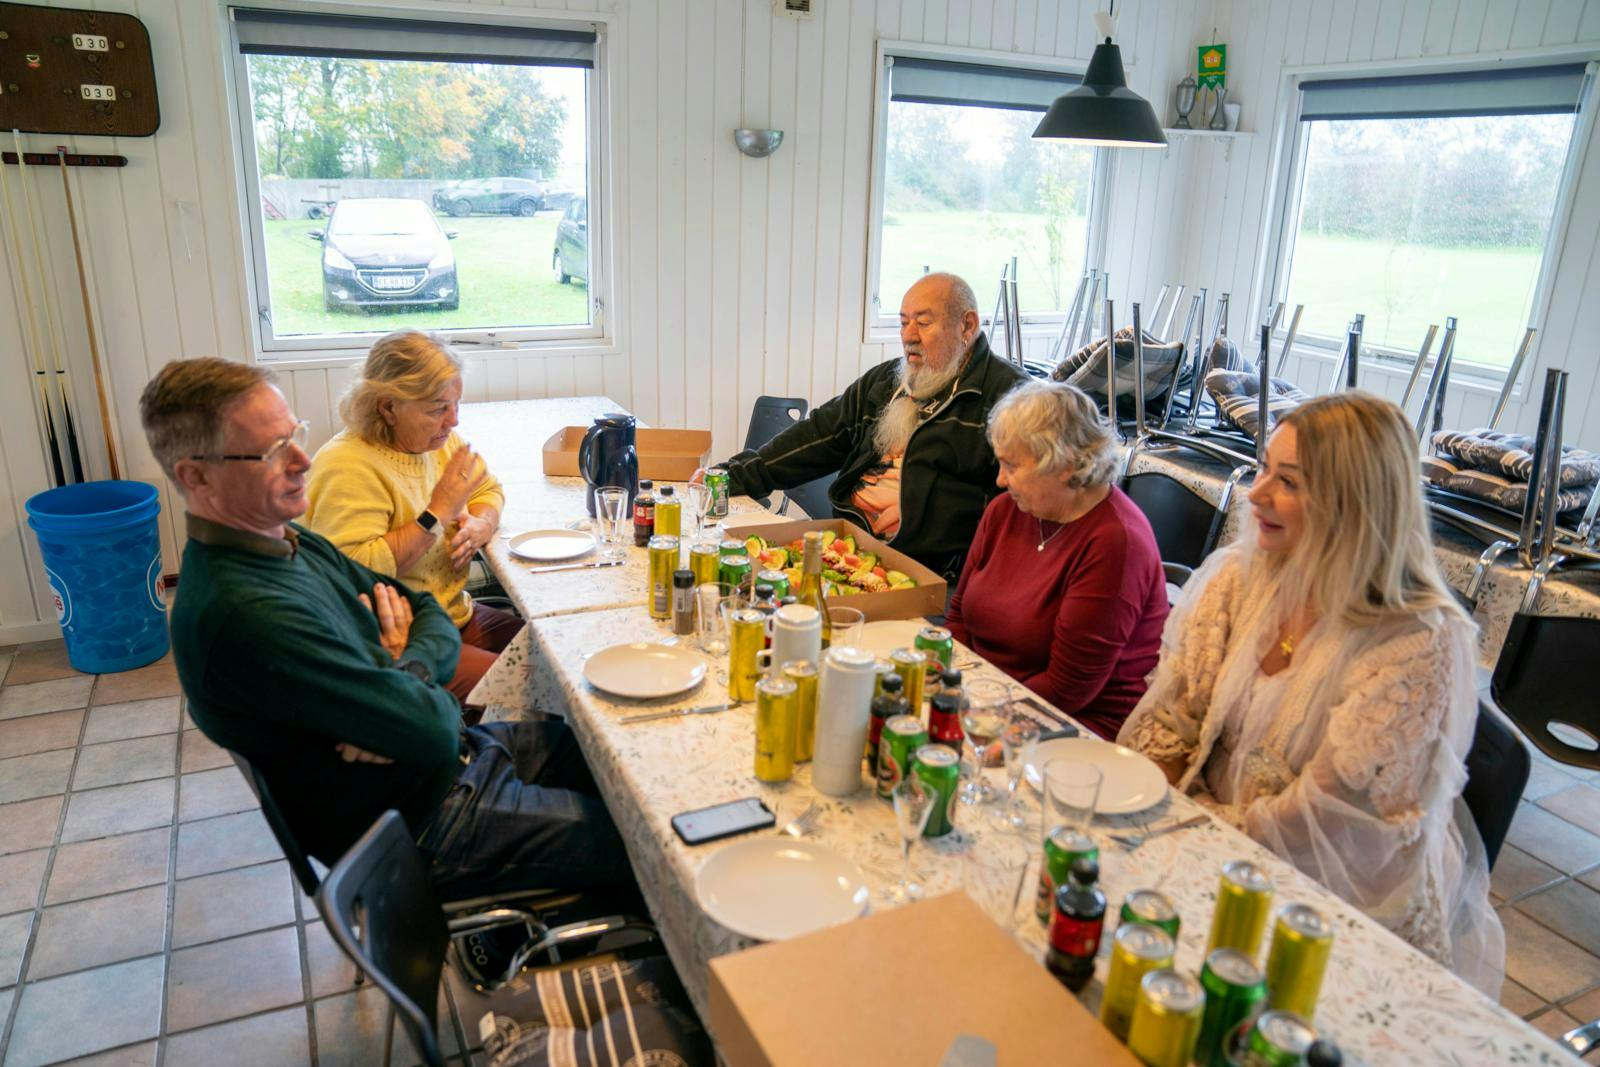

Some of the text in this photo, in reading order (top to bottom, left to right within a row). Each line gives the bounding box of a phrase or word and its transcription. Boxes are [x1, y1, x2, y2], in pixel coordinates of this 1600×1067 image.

[74, 36, 107, 49] 030
[83, 87, 114, 98] 030
[469, 934, 488, 965] CCO
